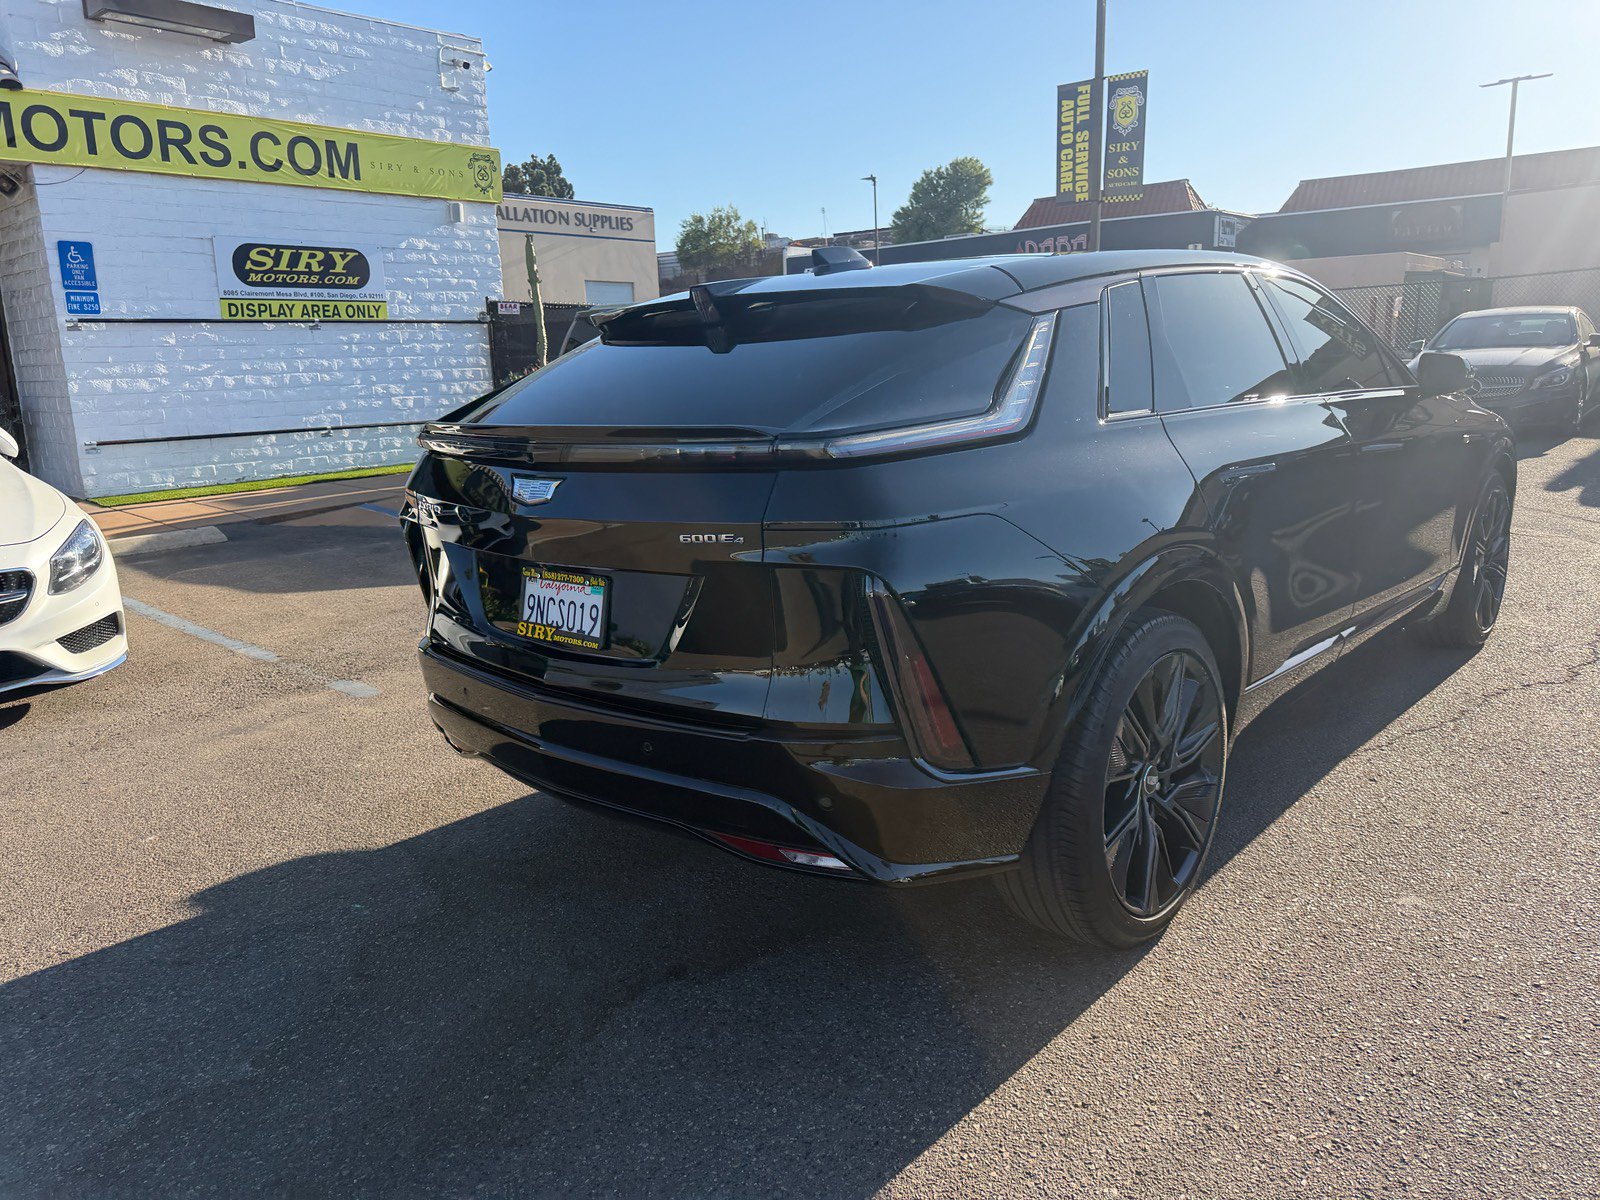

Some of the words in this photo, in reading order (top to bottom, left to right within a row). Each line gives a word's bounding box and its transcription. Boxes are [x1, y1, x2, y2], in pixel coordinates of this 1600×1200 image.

[1076, 84, 1091, 124] FULL
[1060, 100, 1074, 144] AUTO
[1108, 140, 1140, 154] SIRY
[1118, 156, 1128, 164] &
[370, 161, 402, 172] SIRY
[413, 166, 420, 174] &
[430, 168, 464, 178] SONS
[1060, 148, 1074, 193] CARE
[1075, 130, 1090, 202] SERVICE
[1107, 166, 1140, 178] SONS
[496, 205, 570, 226] ALLATION
[574, 212, 634, 231] SUPPLIES
[244, 247, 358, 273] SIRY
[246, 273, 360, 285] MOTORS.COM
[228, 302, 295, 318] DISPLAY
[300, 304, 341, 318] AREA
[345, 304, 381, 318] ONLY
[527, 594, 599, 636] 9NCS019
